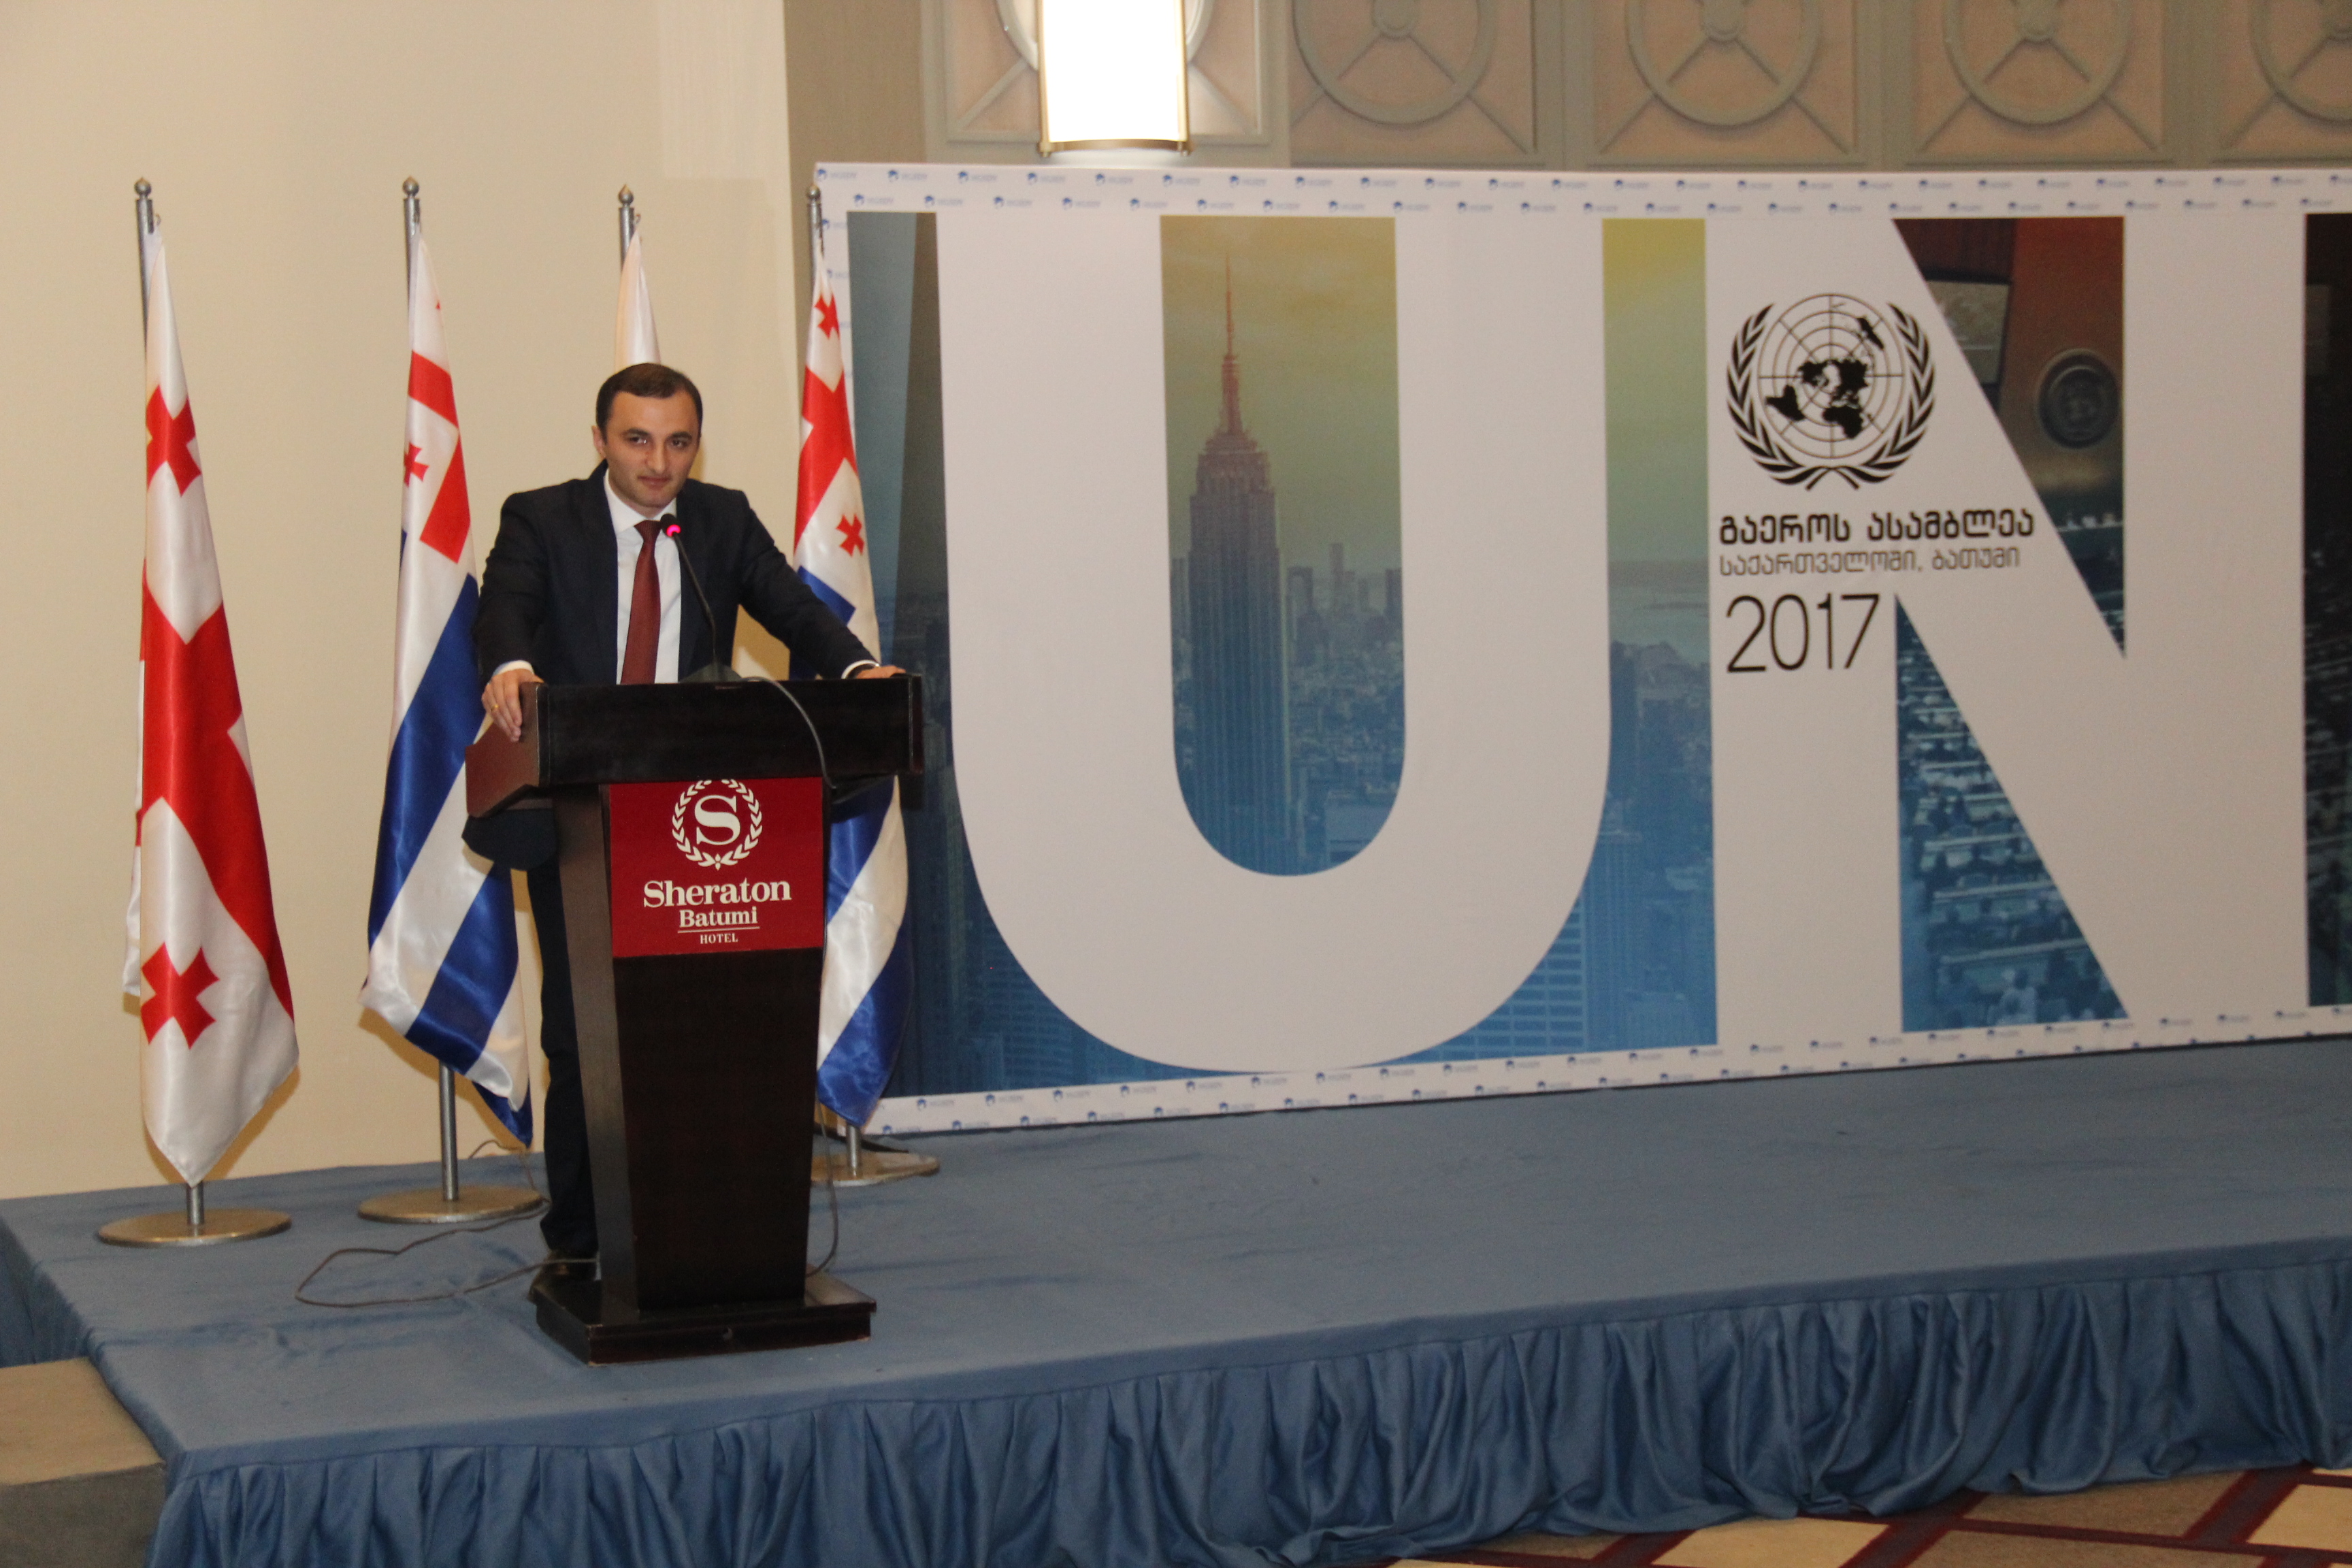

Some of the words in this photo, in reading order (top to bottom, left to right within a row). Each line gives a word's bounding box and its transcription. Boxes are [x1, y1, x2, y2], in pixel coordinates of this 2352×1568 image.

[1720, 514, 1851, 545] გაეროს
[1867, 508, 2034, 542] ასამბლეა
[1720, 550, 1923, 576] საქართველოში,
[1933, 546, 2021, 571] ბათუმი
[935, 212, 2311, 1073] UN
[1726, 593, 1880, 673] 2017
[694, 794, 741, 846] S
[643, 877, 792, 909] Sheraton
[679, 906, 758, 928] Batumi
[700, 932, 738, 945] HOTEL
